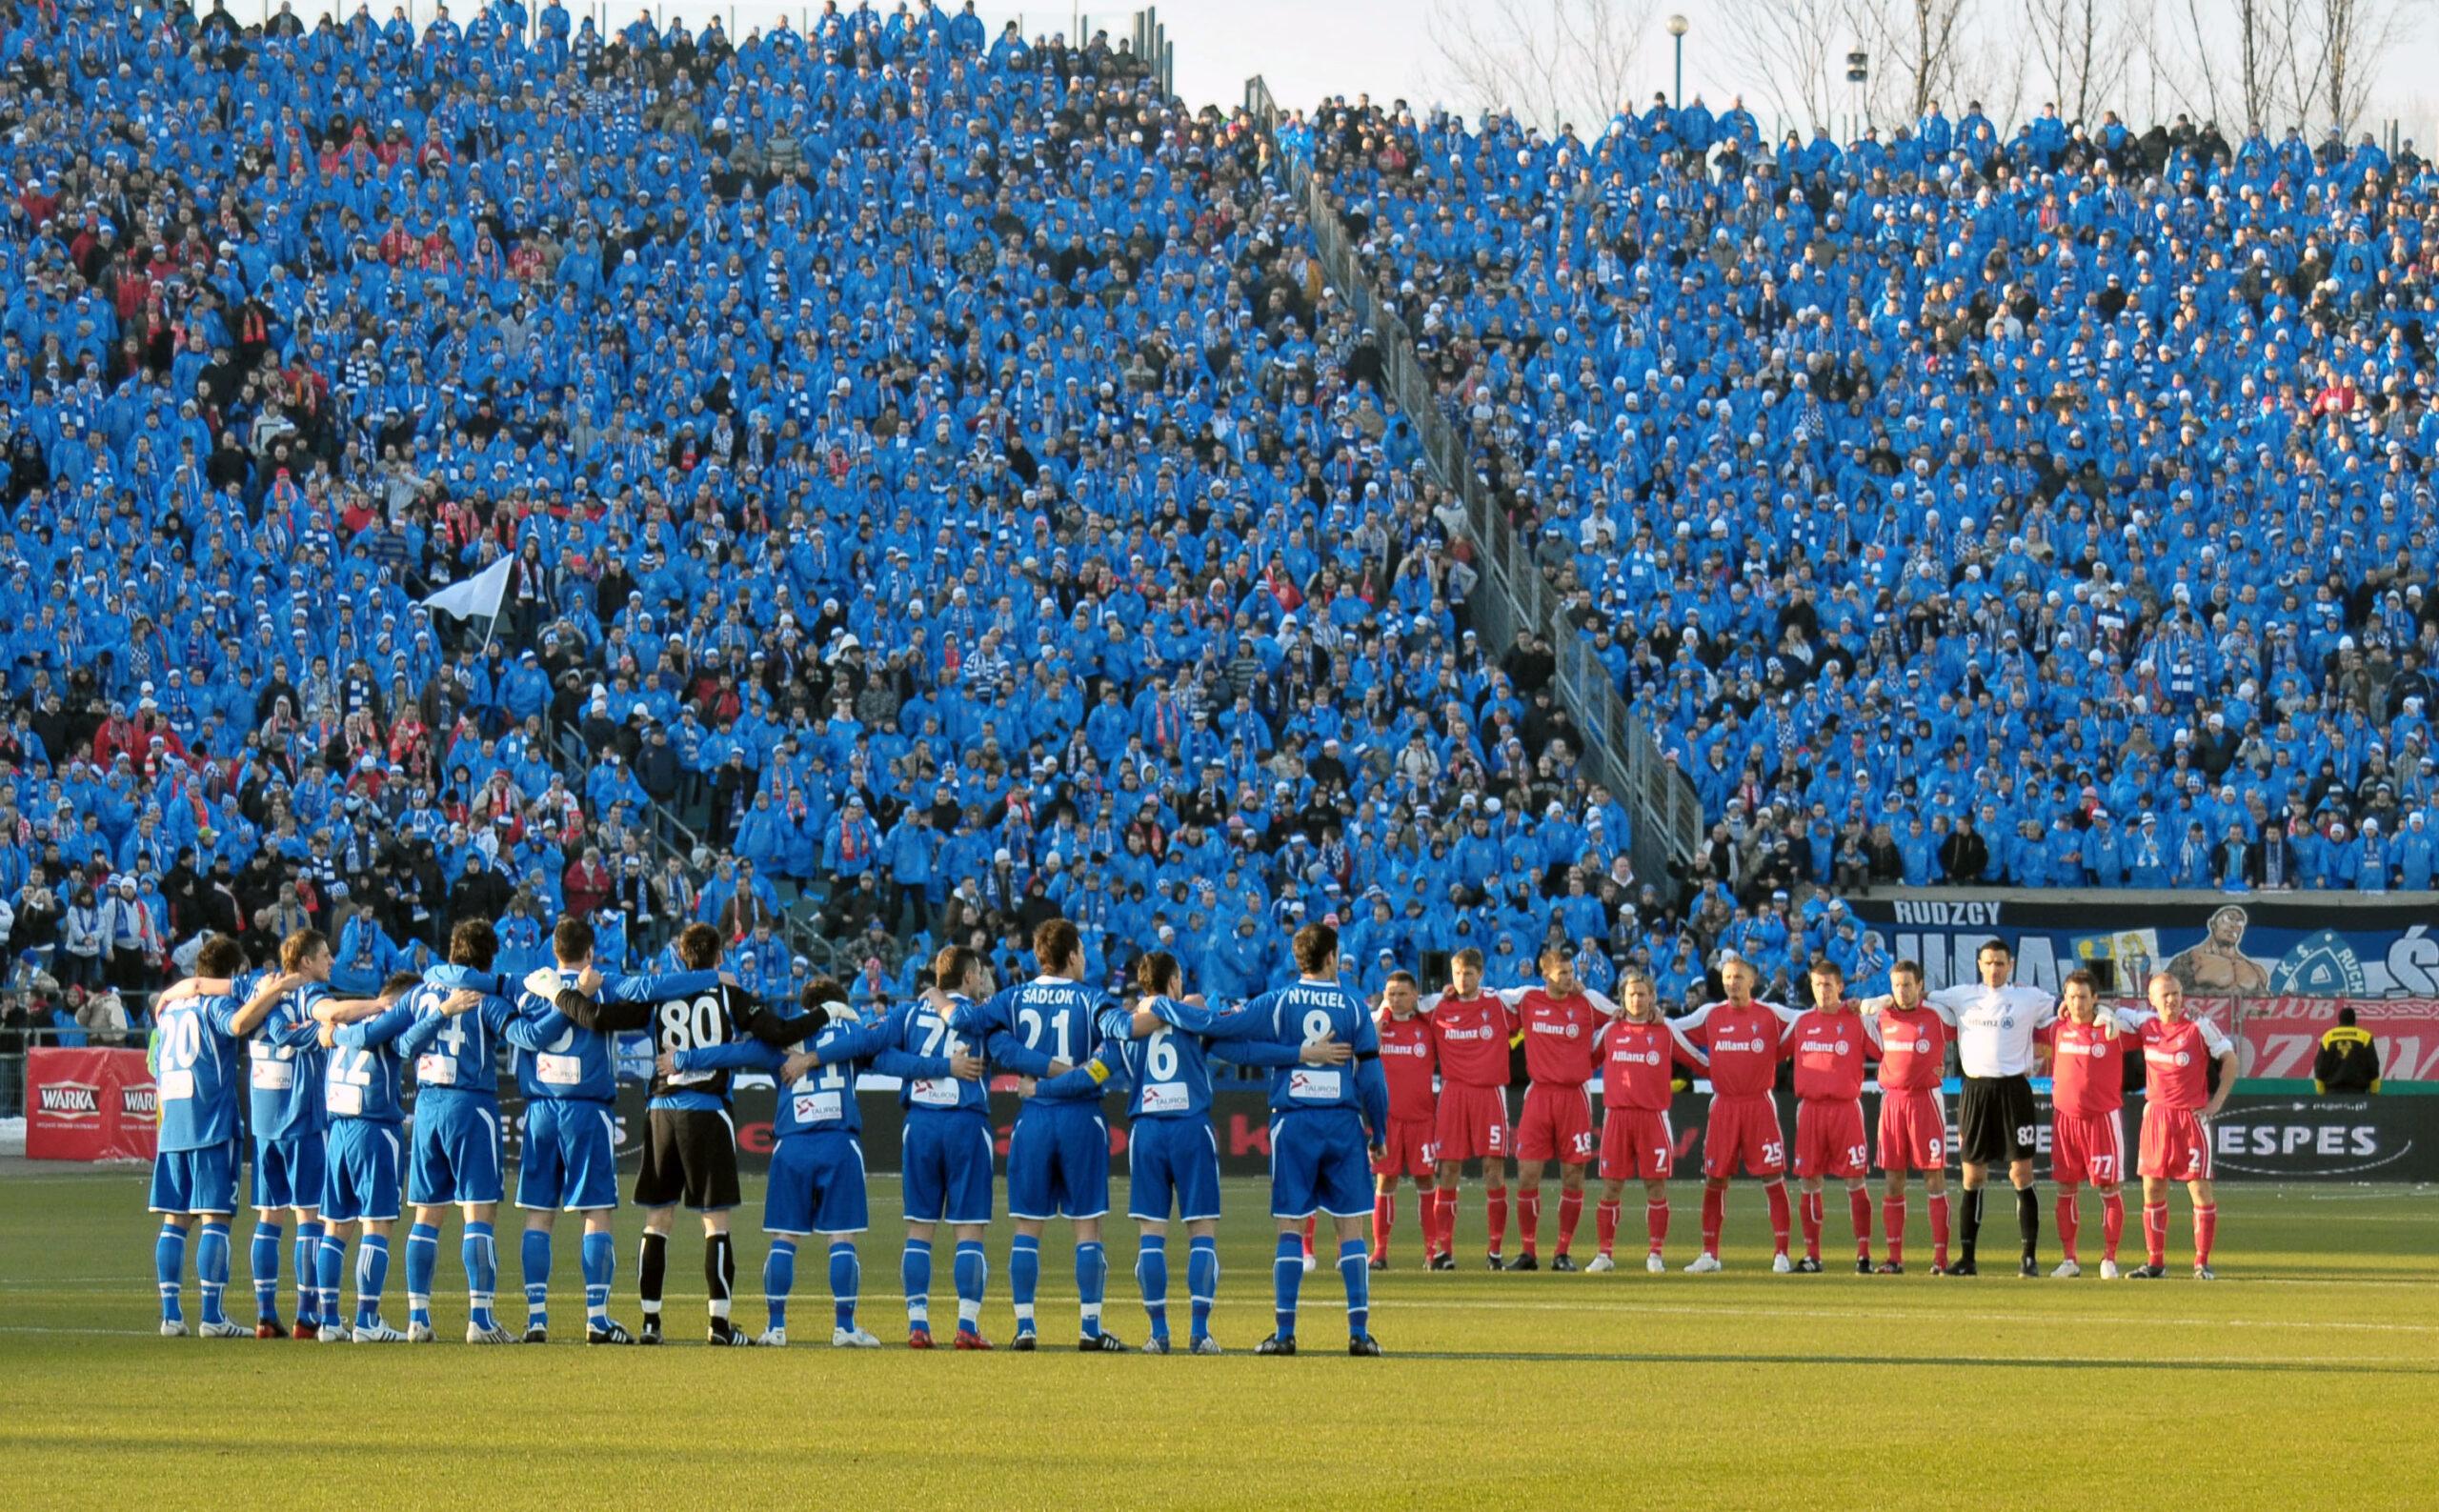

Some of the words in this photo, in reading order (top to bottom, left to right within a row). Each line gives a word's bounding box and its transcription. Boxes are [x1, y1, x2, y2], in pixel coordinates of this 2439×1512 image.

[1893, 900, 2002, 926] RUDZCY
[2338, 947, 2365, 993] RUCH
[1021, 988, 1076, 1006] SADLOK
[1288, 988, 1346, 1009] NYKIEL
[2245, 998, 2335, 1020] KLUB
[660, 996, 722, 1051] 80
[1444, 1029, 1478, 1039] Allianz
[1532, 1021, 1564, 1035] Allianz
[158, 1011, 200, 1071] 20
[1018, 1008, 1073, 1066] 21
[1302, 1009, 1332, 1067] 8
[1715, 1040, 1750, 1052] Allianz
[1800, 1040, 1834, 1052] Allianz
[792, 1031, 845, 1095] 11
[1148, 1024, 1178, 1081] 6
[1612, 1051, 1645, 1062] Allianz
[1304, 1084, 1339, 1093] TAURON
[41, 1089, 96, 1110] WARKA
[124, 1091, 157, 1111] WAR
[1489, 1124, 1502, 1144] 5
[1573, 1131, 1591, 1153] 18
[2017, 1125, 2035, 1146] 82
[2217, 1125, 2378, 1156] ESPES
[1654, 1148, 1665, 1168] 7
[1762, 1143, 1783, 1163] 25
[1847, 1145, 1867, 1166] 19
[2188, 1149, 2200, 1168] 2
[2091, 1155, 2113, 1175] 77
